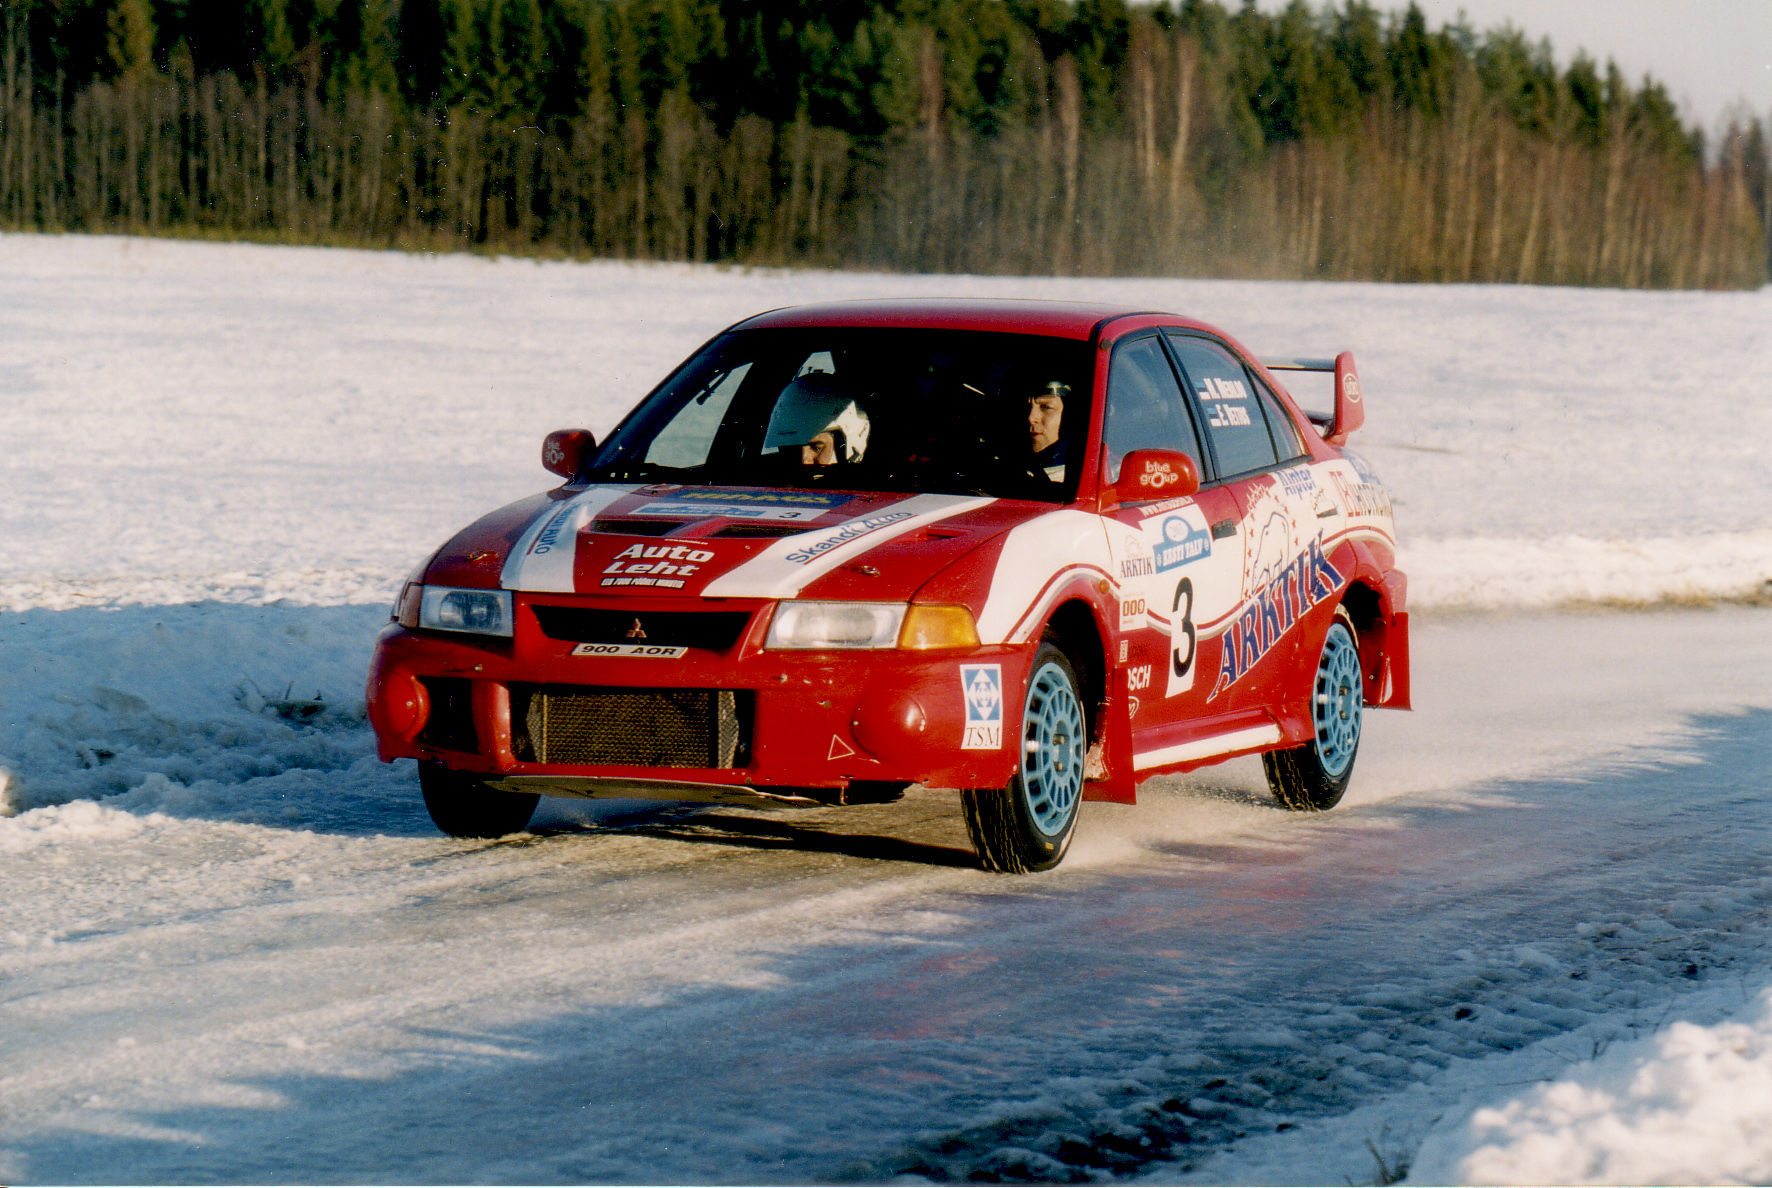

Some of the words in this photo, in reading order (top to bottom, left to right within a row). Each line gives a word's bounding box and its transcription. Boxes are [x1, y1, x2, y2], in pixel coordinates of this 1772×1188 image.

[1145, 460, 1171, 472] blue
[1139, 470, 1179, 488] group
[785, 524, 864, 563] Skandi
[861, 511, 914, 530] Auto
[612, 543, 716, 563] Auto
[601, 561, 701, 576] Leht
[1120, 556, 1153, 578] ARKTIK
[1206, 527, 1346, 704] ARKTIK
[1171, 576, 1195, 678] 3
[581, 645, 621, 654] 900
[630, 646, 677, 656] AOR
[965, 726, 1001, 747] TSM
